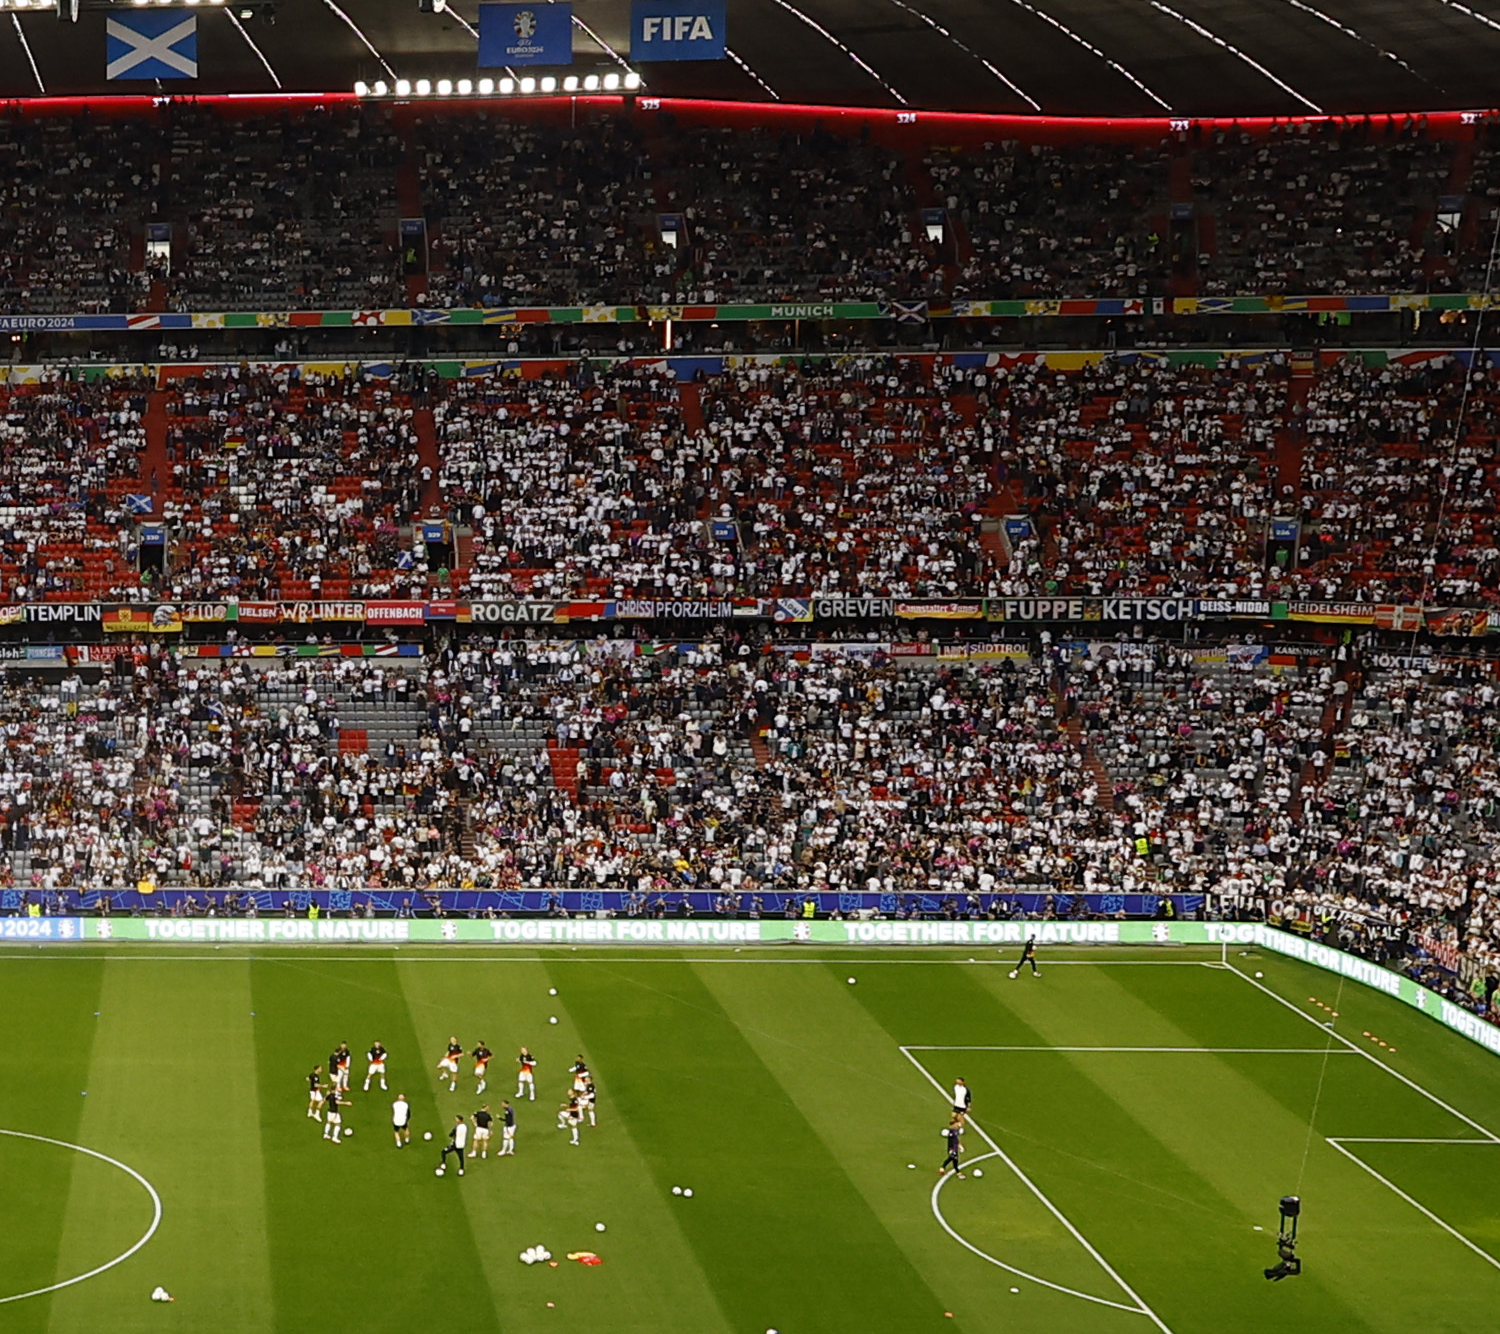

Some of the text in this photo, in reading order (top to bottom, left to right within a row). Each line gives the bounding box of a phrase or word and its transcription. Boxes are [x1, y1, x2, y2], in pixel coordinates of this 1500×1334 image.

[643, 17, 713, 41] FIFA
[771, 307, 834, 317] MUNICH
[26, 605, 100, 622] TEMPLIN
[239, 607, 276, 619] UELSEN
[367, 607, 423, 619] OFFENBACH
[470, 602, 555, 621] ROGÄTZ
[656, 602, 732, 618] PFORZHEIM
[820, 600, 894, 617] GREVEN
[1004, 600, 1083, 620] FUPPE
[1102, 600, 1194, 620] KETSCH
[1287, 603, 1374, 616] HEIDELSHEIM
[969, 641, 1030, 654] SÜDTIROL
[144, 919, 409, 939] TOGETHER FOR NATURE
[490, 920, 761, 940] TOGETHER FOR NATURE
[843, 921, 1119, 942] TOGETHER FOR NATURE
[1203, 922, 1307, 961] TOGETHER
[1306, 942, 1341, 971] FOR
[1341, 953, 1401, 996] NATURE
